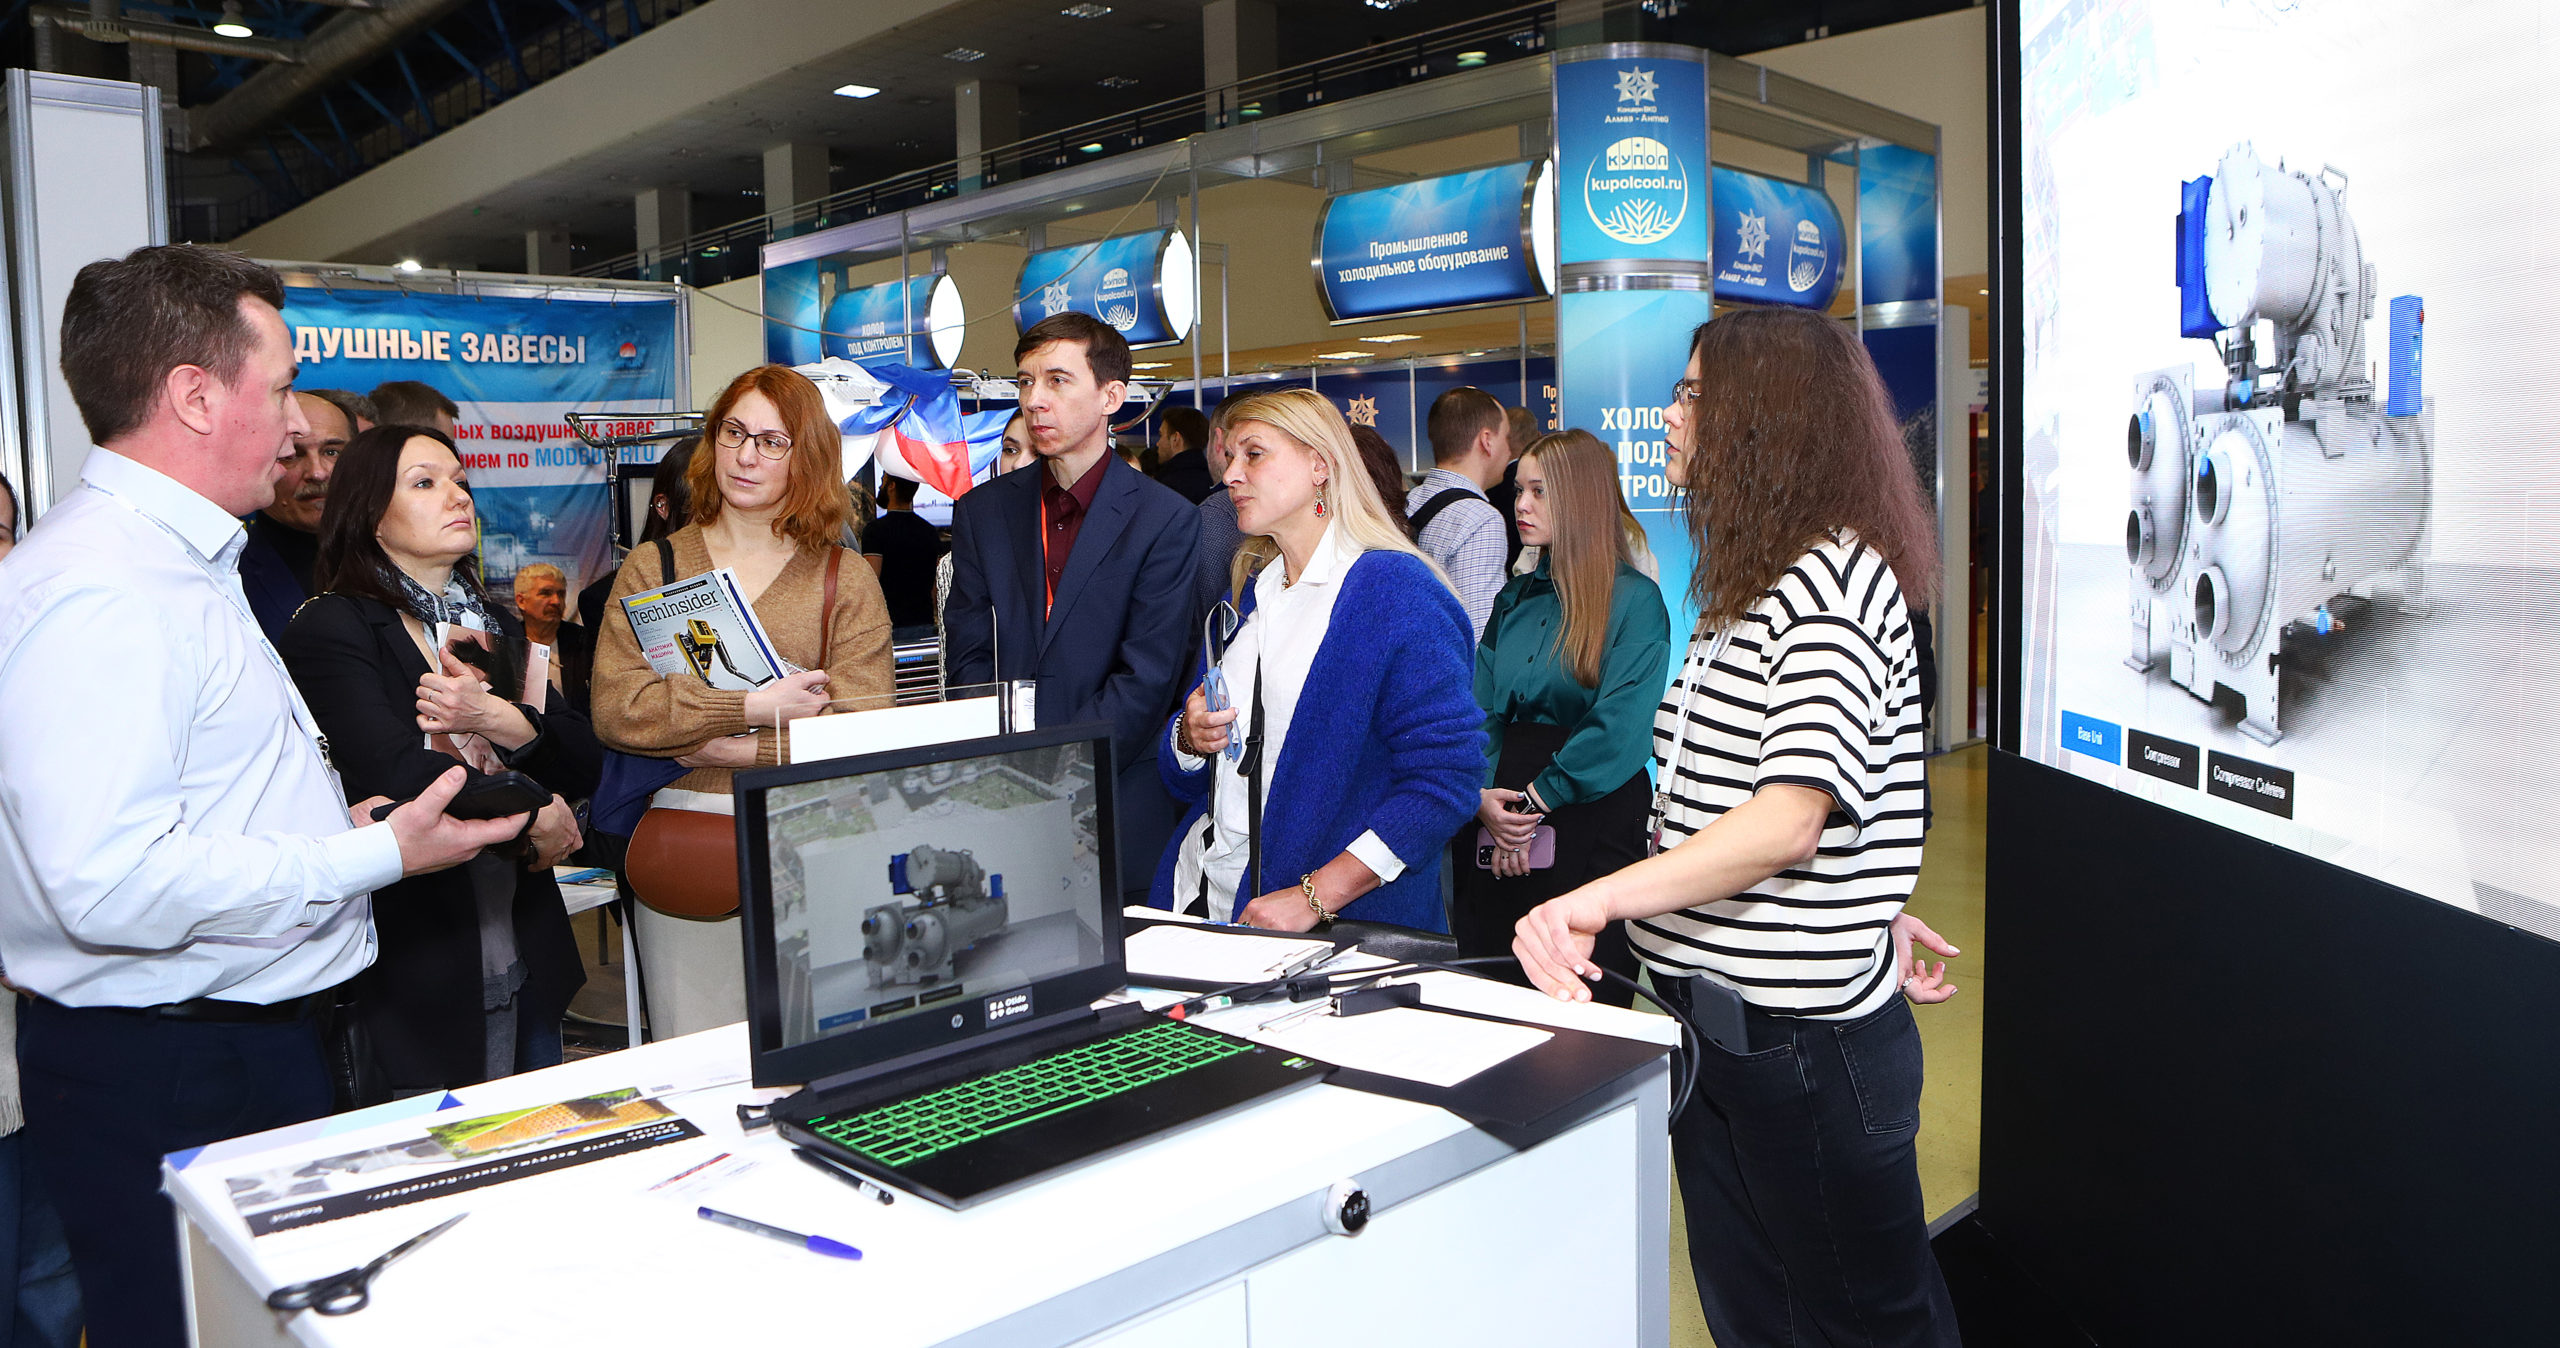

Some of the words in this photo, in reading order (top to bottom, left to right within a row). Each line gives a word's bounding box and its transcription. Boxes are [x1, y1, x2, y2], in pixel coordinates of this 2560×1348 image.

[1608, 154, 1668, 167] КУПОЛ
[1591, 175, 1683, 193] kupolcool.ru
[1369, 230, 1469, 261] Промышленное
[1337, 259, 1416, 284] холодильное
[1417, 245, 1510, 272] оборудование
[862, 321, 885, 337] ХОЛОД
[293, 325, 451, 364] ДУШНЫЕ
[460, 331, 586, 365] ЗАВЕСЫ
[848, 342, 864, 356] ПОД
[863, 335, 904, 352] КОНТРОЛЕМ
[605, 420, 655, 438] завес
[1601, 407, 1670, 433] ХОЛО
[507, 452, 529, 469] по
[535, 446, 608, 467] MODBU
[1618, 441, 1666, 467] ПОД
[630, 590, 720, 626] TechInsider
[2078, 726, 2091, 742] Base
[2143, 745, 2182, 770] Compressor
